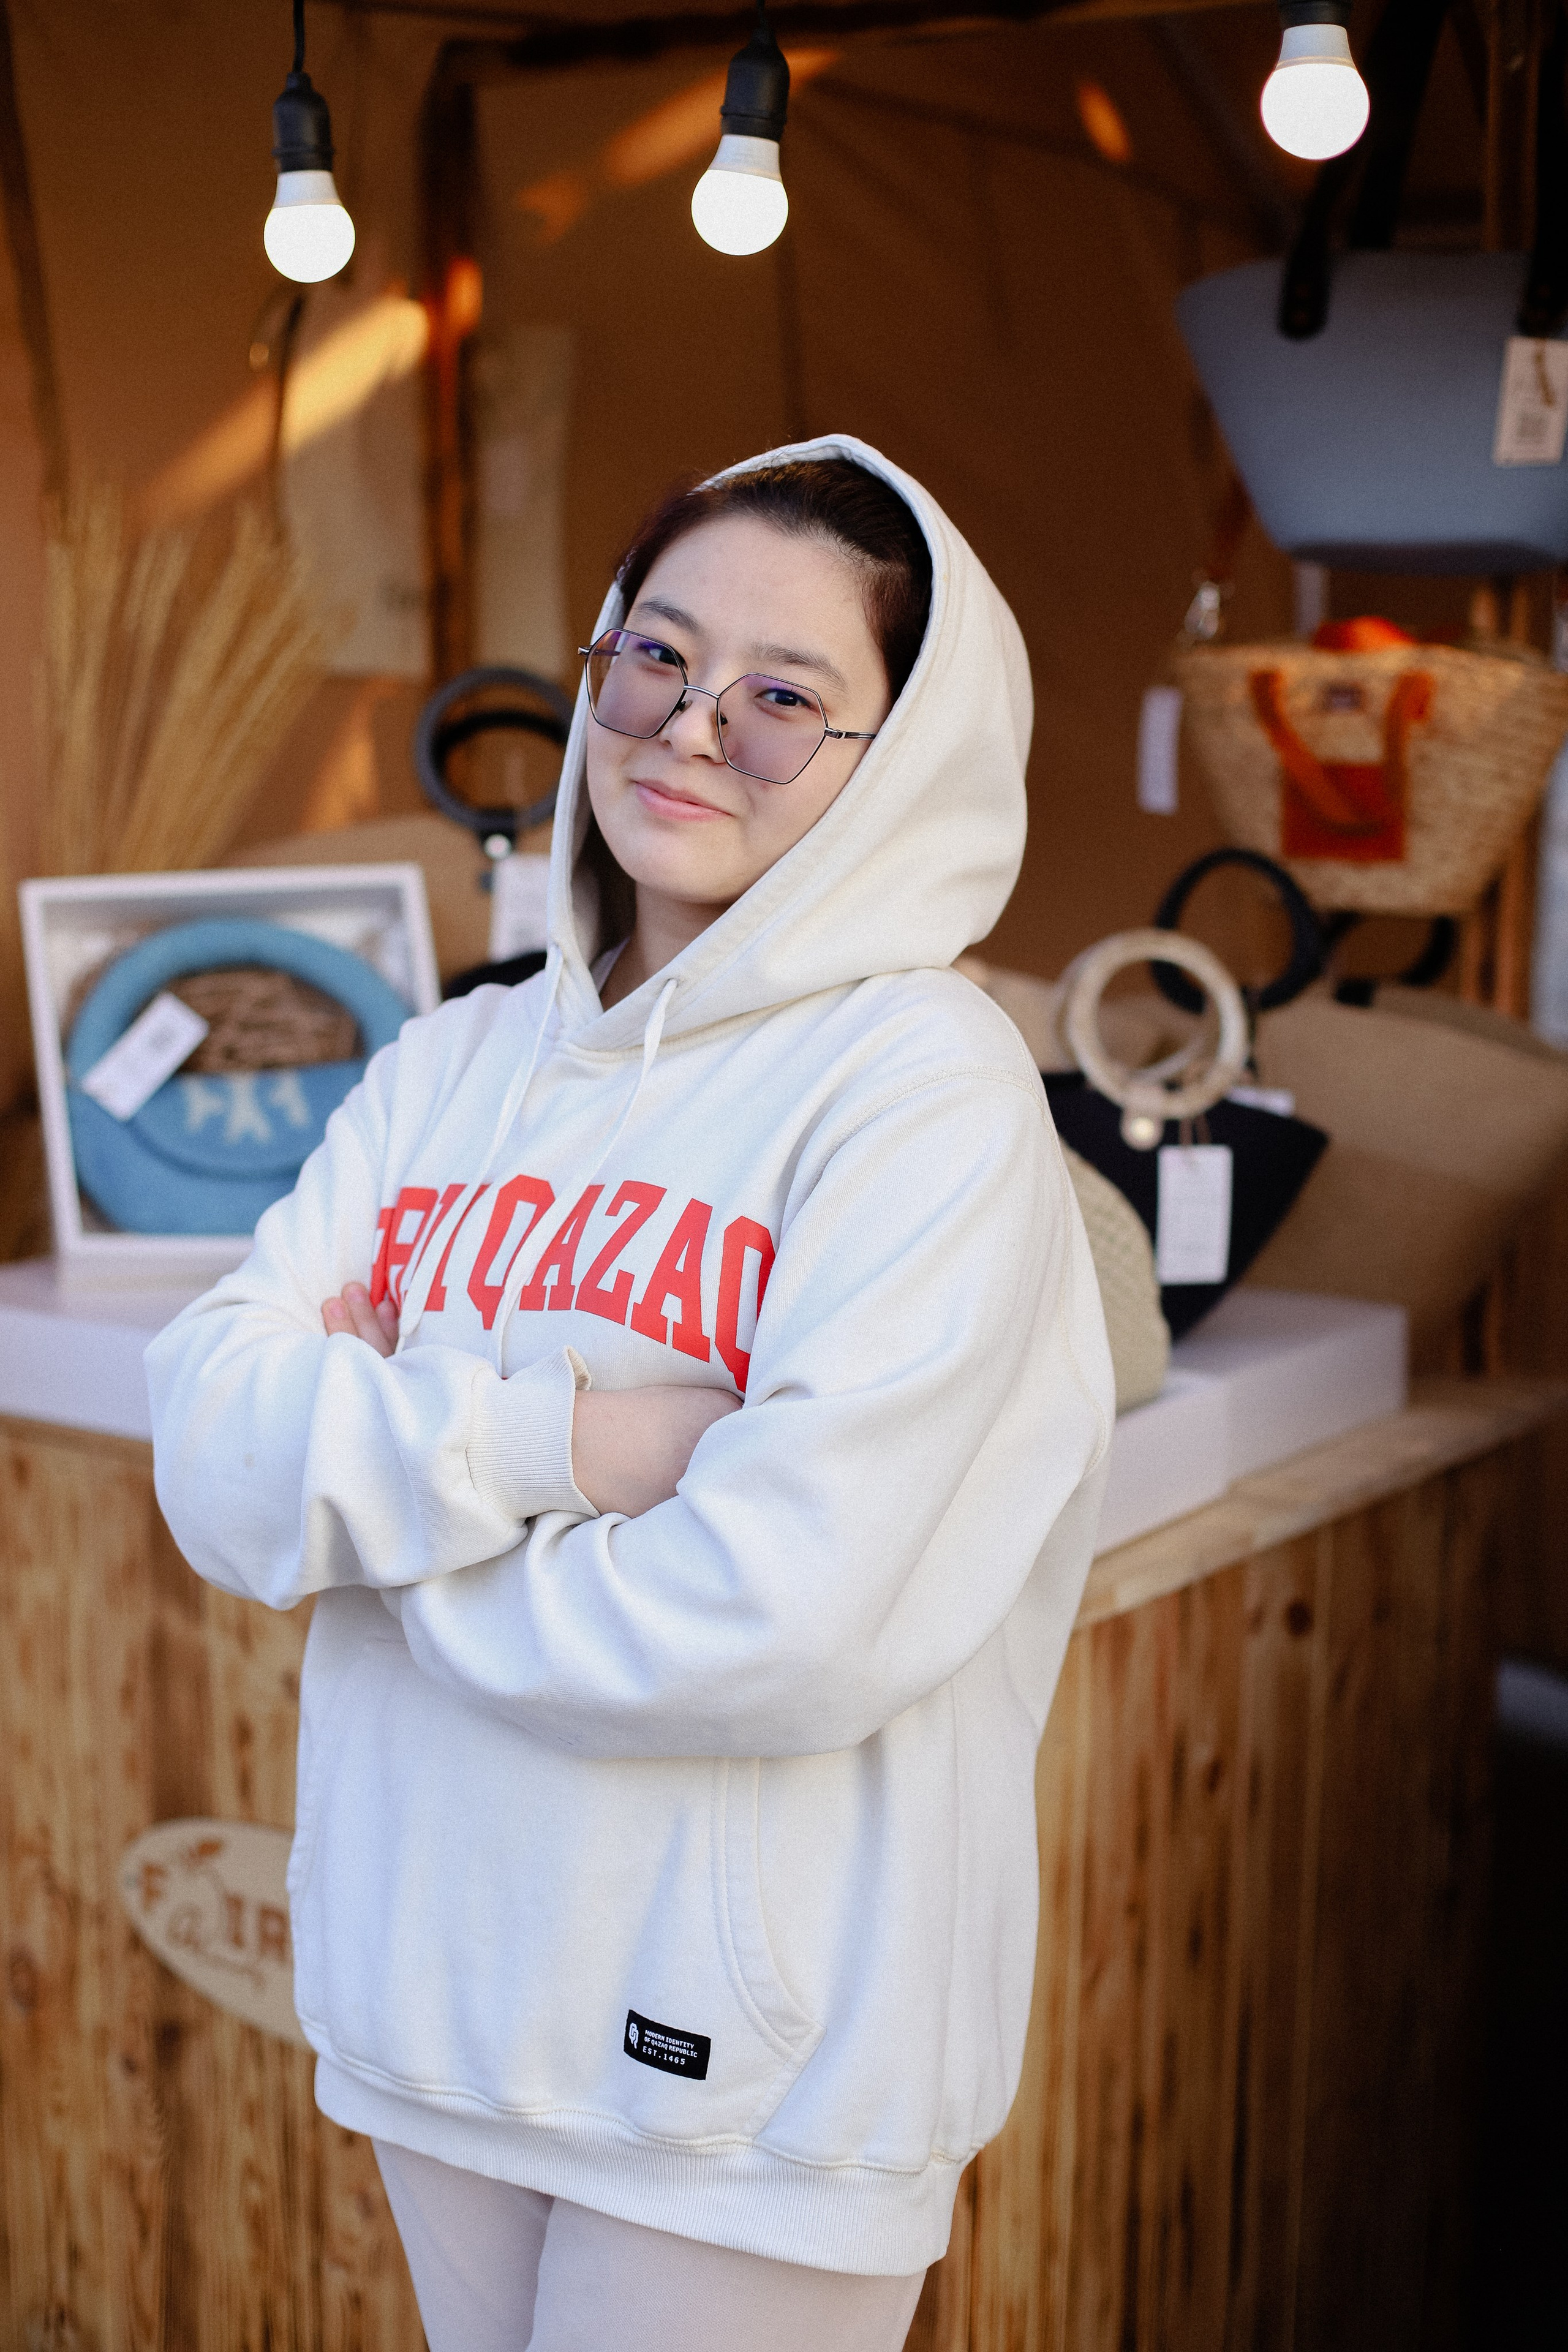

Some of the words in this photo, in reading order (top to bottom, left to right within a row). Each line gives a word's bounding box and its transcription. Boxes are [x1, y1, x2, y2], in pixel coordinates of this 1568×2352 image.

[466, 1173, 776, 1394] QAZAQ
[645, 2029, 665, 2041] MODERN
[666, 2037, 695, 2049] IDENTITY
[651, 2039, 668, 2051] QAZAQ
[669, 2045, 698, 2058] REPUBLIC
